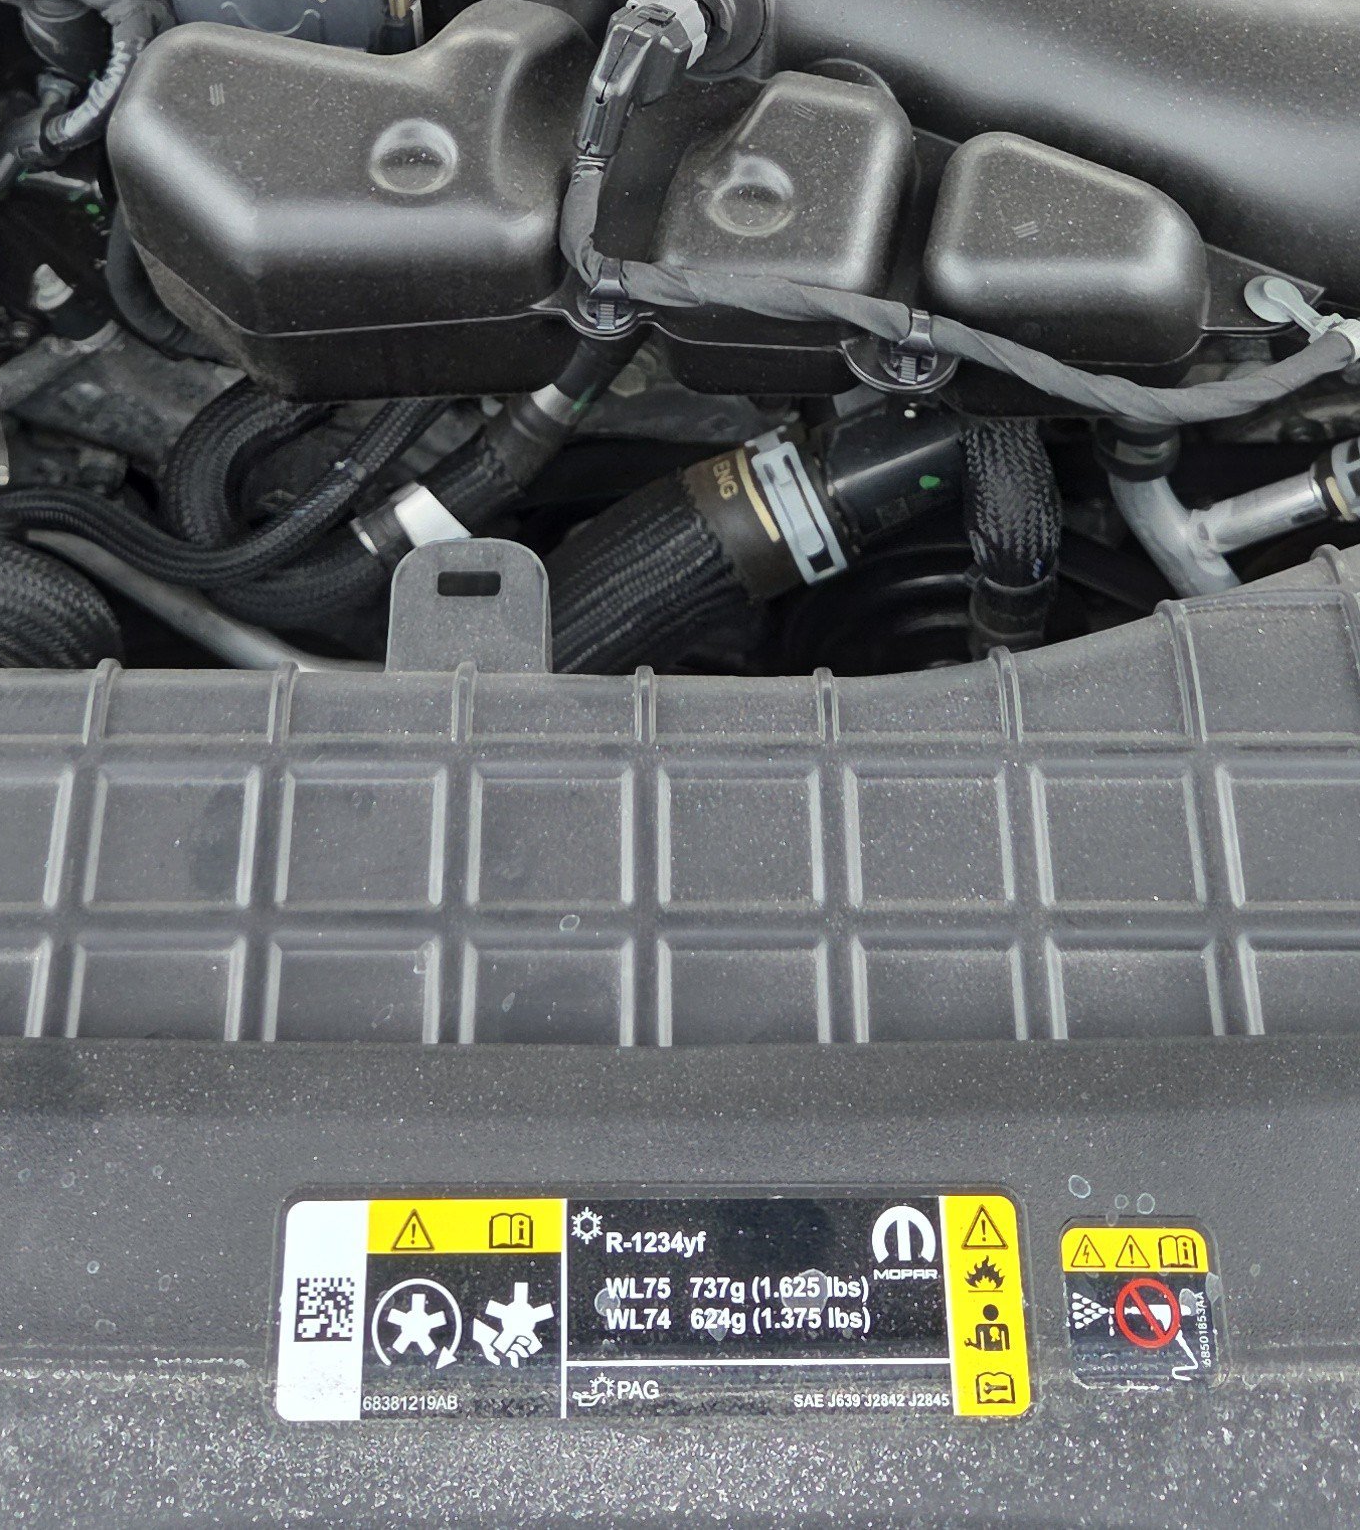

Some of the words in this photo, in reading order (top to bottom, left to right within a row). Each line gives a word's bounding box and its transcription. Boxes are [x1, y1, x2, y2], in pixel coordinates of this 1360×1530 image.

[605, 1231, 707, 1258] R-1234yf
[873, 1268, 938, 1281] MOPAR
[605, 1277, 671, 1299] WL75
[690, 1277, 746, 1303] 737g
[752, 1276, 821, 1303] (1.625
[827, 1275, 870, 1302] lbs)
[605, 1308, 671, 1330] WL74
[690, 1308, 746, 1334] 624g
[752, 1307, 821, 1334] (1.375
[828, 1307, 871, 1334] lbs)
[617, 1380, 659, 1400] PAG
[793, 1393, 824, 1408] SAE
[827, 1392, 860, 1408] J639
[863, 1392, 905, 1408] J2842
[907, 1392, 950, 1407] J2845
[362, 1395, 459, 1411] 68381219AB
